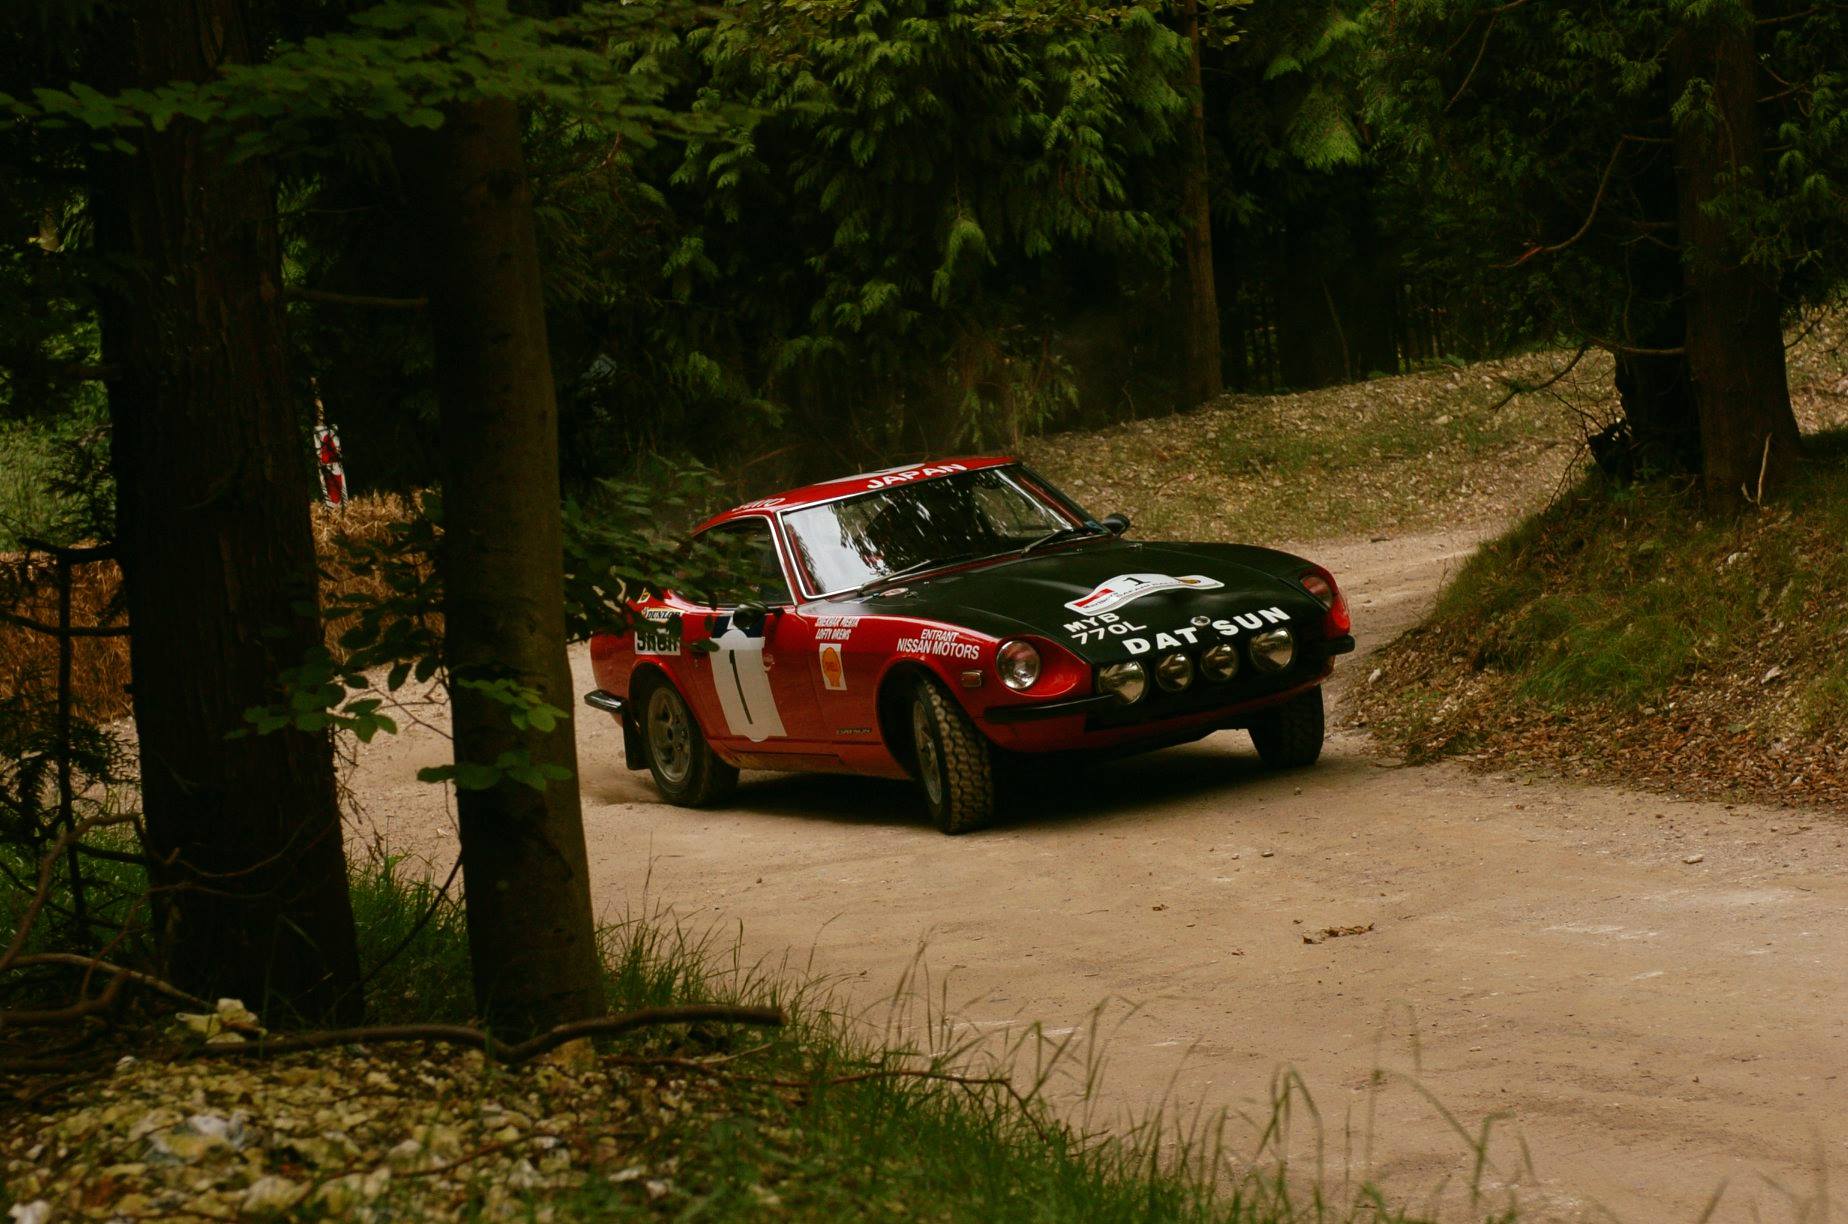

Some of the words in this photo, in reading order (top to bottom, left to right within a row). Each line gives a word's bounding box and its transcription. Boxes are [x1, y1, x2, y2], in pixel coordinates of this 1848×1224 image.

[866, 463, 968, 490] JAPAN
[1122, 577, 1151, 587] 1
[1063, 612, 1120, 633] MYB
[1071, 621, 1148, 645] 770L
[921, 628, 960, 642] ENTRANT
[896, 638, 933, 654] NISSAN
[932, 641, 980, 660] MOTORS
[729, 649, 753, 725] 1
